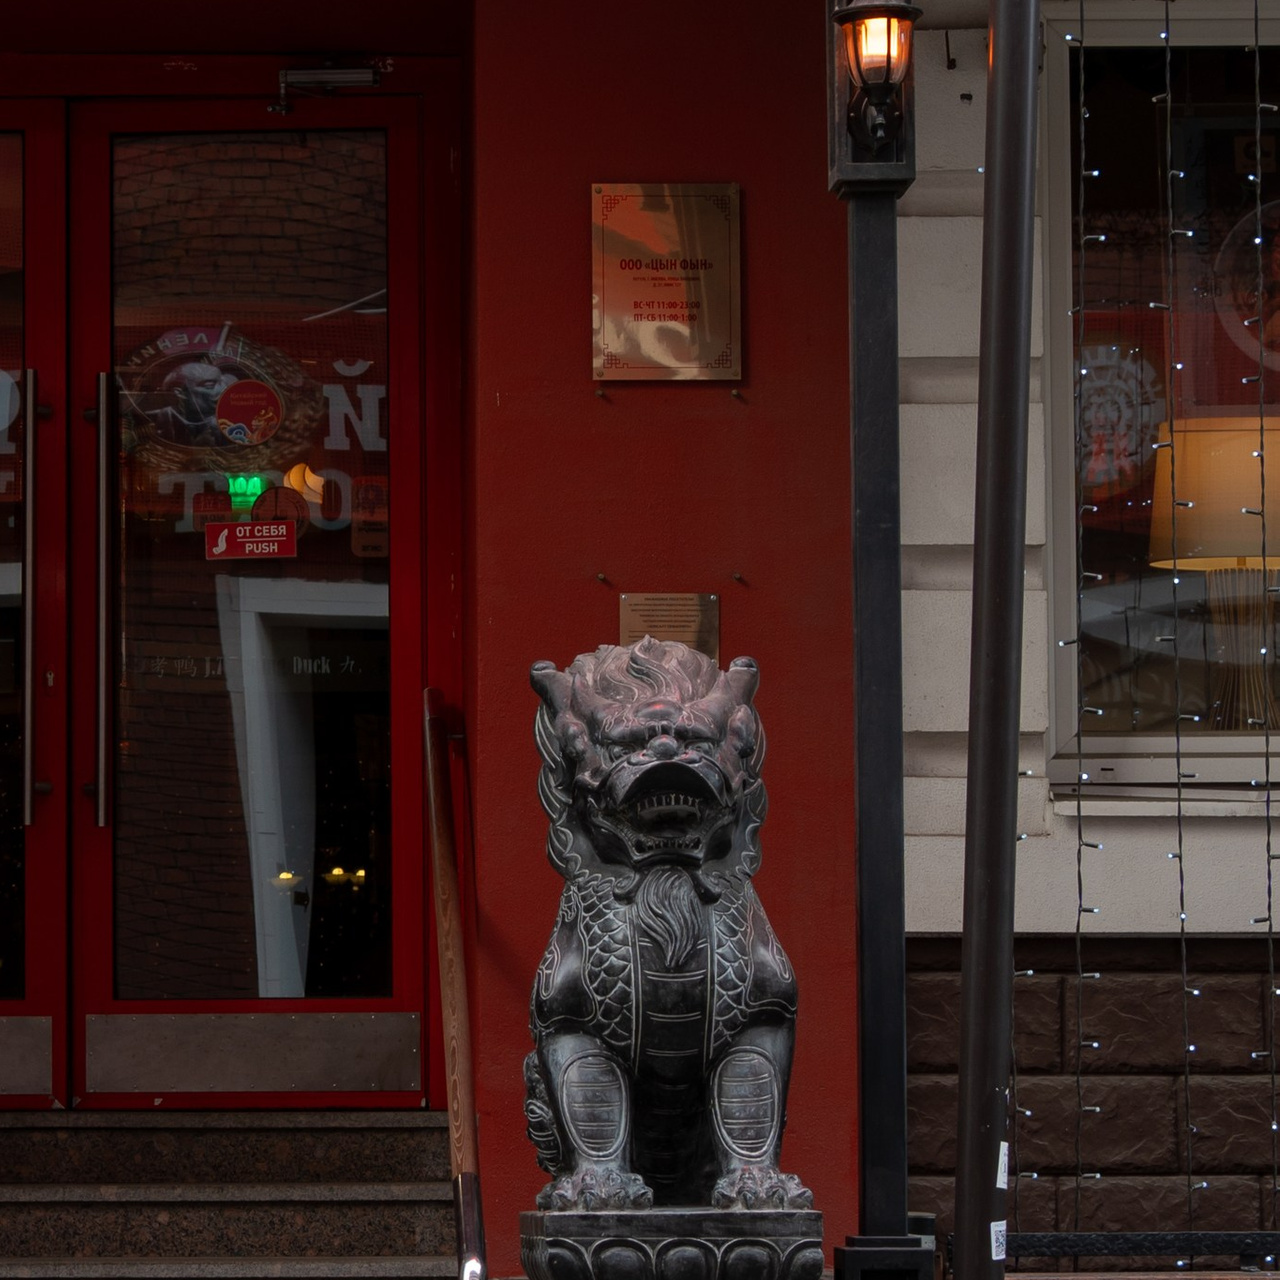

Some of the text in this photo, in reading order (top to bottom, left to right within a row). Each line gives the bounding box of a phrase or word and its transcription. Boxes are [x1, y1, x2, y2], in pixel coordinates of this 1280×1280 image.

[236, 525, 287, 537] ОТ СЕБЯ
[245, 542, 278, 554] PUSH
